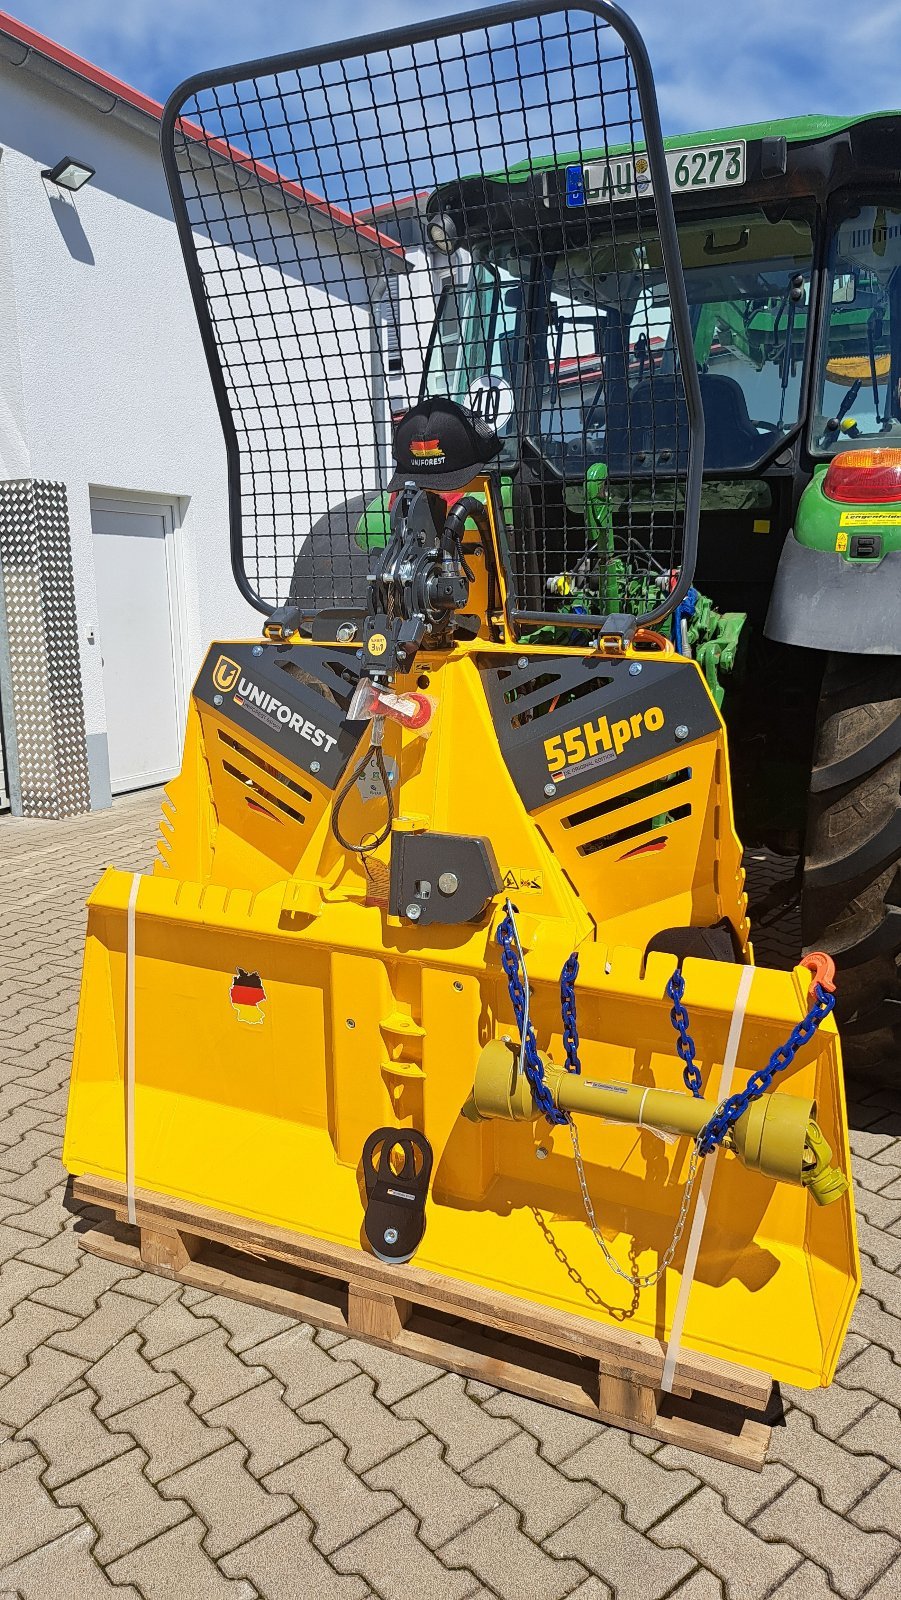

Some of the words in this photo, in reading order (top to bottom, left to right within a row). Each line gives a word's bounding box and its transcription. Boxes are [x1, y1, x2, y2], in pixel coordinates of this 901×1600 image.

[584, 162, 632, 199] LAU
[675, 147, 741, 187] 6273
[472, 386, 500, 423] 40
[411, 456, 445, 465] UNIFOREST
[237, 677, 337, 753] UNIFOREST
[543, 706, 665, 771] 55Hpro
